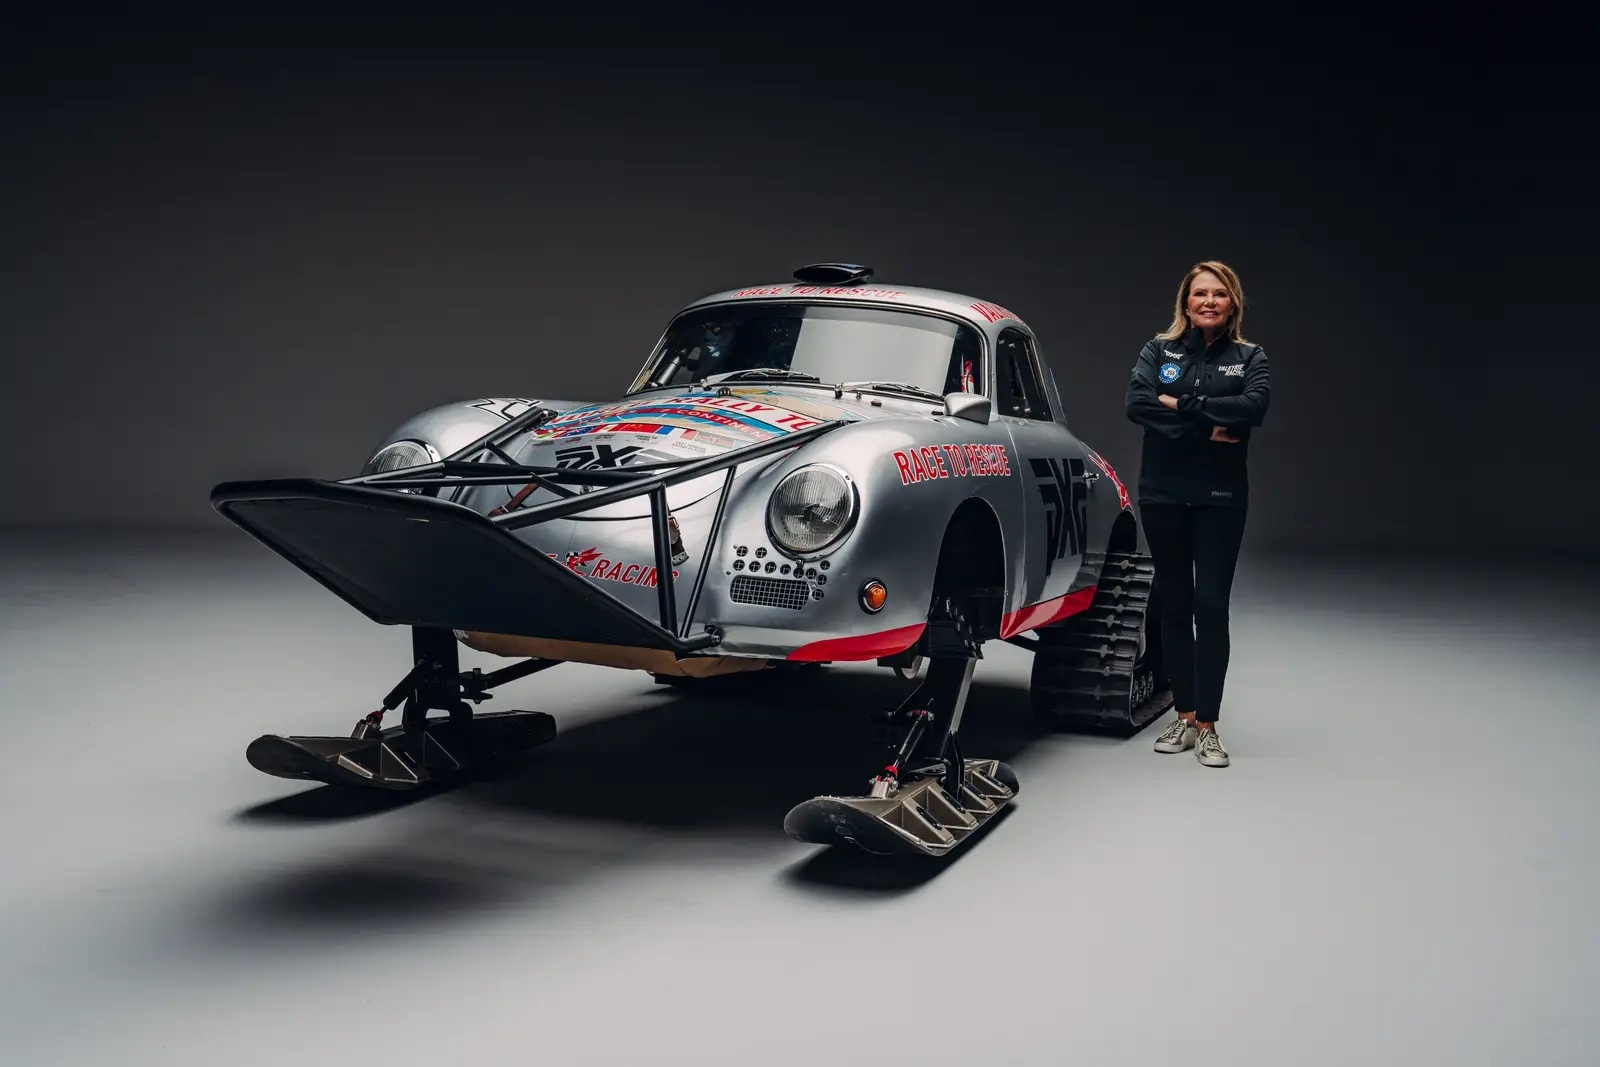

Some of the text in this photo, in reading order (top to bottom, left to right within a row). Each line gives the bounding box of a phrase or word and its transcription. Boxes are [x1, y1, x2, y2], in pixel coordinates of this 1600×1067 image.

[733, 285, 907, 299] RACE TO RESCUE
[663, 397, 775, 413] RALLY
[892, 443, 1012, 486] RACE TO RESCUE
